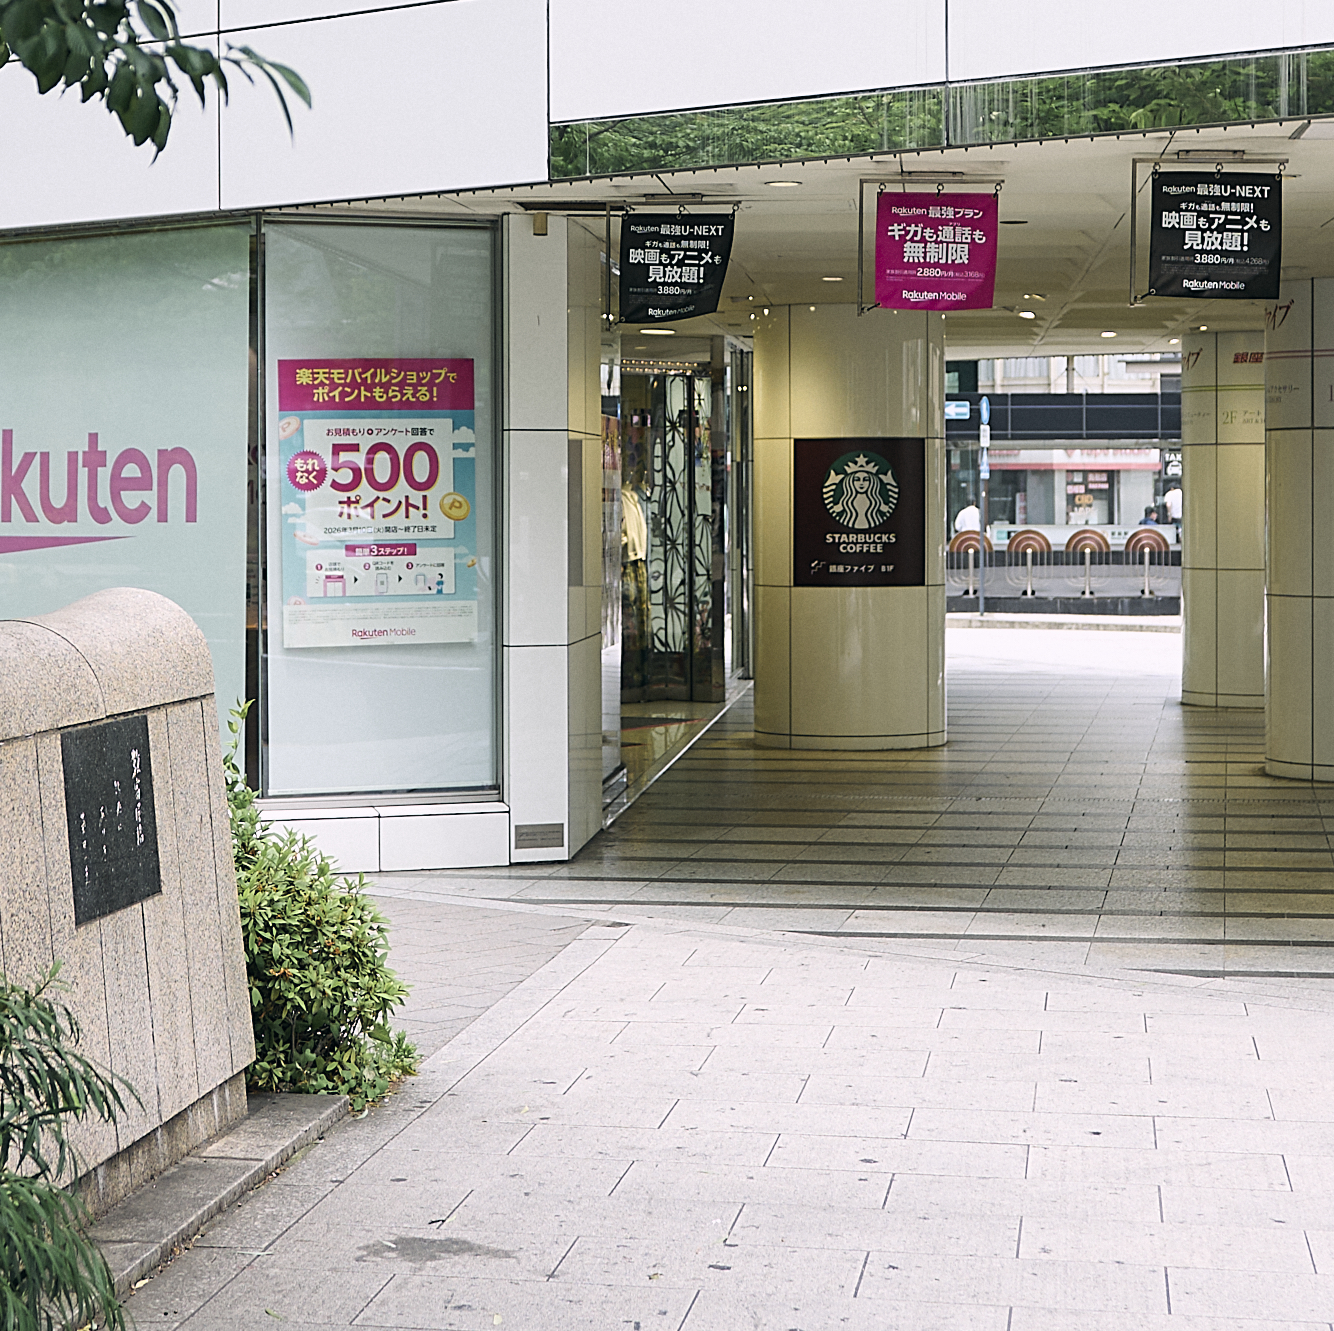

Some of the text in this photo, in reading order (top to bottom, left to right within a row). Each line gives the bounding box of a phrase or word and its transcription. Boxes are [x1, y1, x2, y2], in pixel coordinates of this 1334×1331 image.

[1163, 184, 1270, 198] Rakuten 最強U-NEXT
[892, 206, 983, 218] Rakuten 最強プラン
[1162, 211, 1270, 231] 映画もアニメも
[630, 225, 724, 235] Rakuten 最強U-NEXT
[888, 223, 986, 243] ギガも通話も
[1183, 231, 1248, 251] 見放題!
[629, 249, 722, 264] 映画もアニメも
[903, 242, 969, 264] 無制限
[648, 266, 704, 283] 見放題!
[1183, 280, 1245, 290] Rakuten Mobile
[903, 290, 966, 301] Rakuten Mobile
[648, 307, 676, 317] Rakuten
[1233, 352, 1264, 363] 銀座
[296, 367, 457, 385] 楽天モバイルショップで
[313, 386, 437, 402] ポイントもらえる!
[1223, 411, 1237, 424] 2F
[295, 458, 319, 470] もれ
[329, 442, 439, 492] 500
[296, 472, 317, 484] なく
[338, 495, 429, 520] ポイント!
[826, 534, 896, 543] STARBUCKS
[840, 544, 883, 553] COFFEE
[352, 627, 416, 639] Rakuten Mobile
